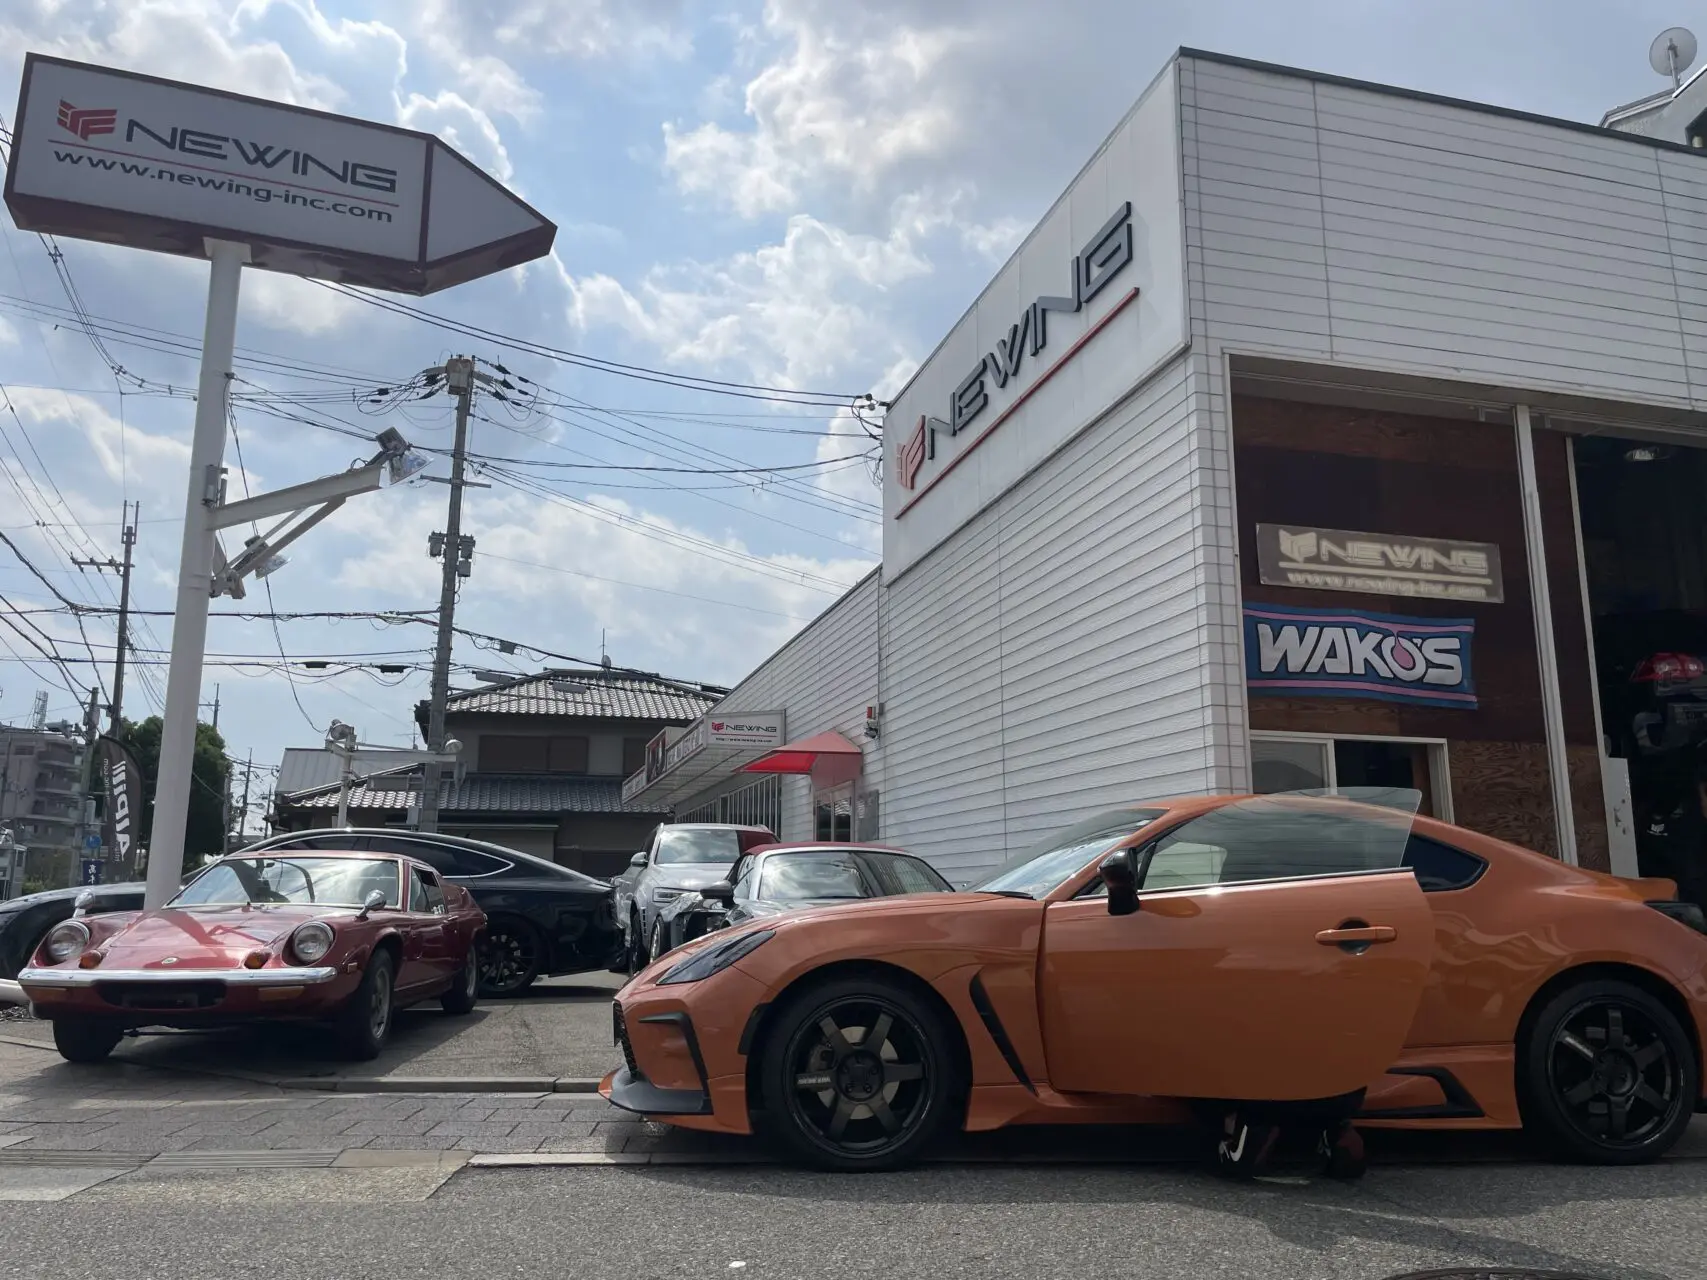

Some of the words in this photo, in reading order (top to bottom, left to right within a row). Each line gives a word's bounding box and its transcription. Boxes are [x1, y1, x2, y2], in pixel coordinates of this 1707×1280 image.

[53, 149, 392, 223] www.newing-inc.com
[126, 118, 398, 194] NEWING
[927, 201, 1133, 460] NEWING
[1320, 537, 1489, 576] NEWING
[1256, 622, 1463, 686] WAKO'S
[725, 724, 777, 733] NEWING
